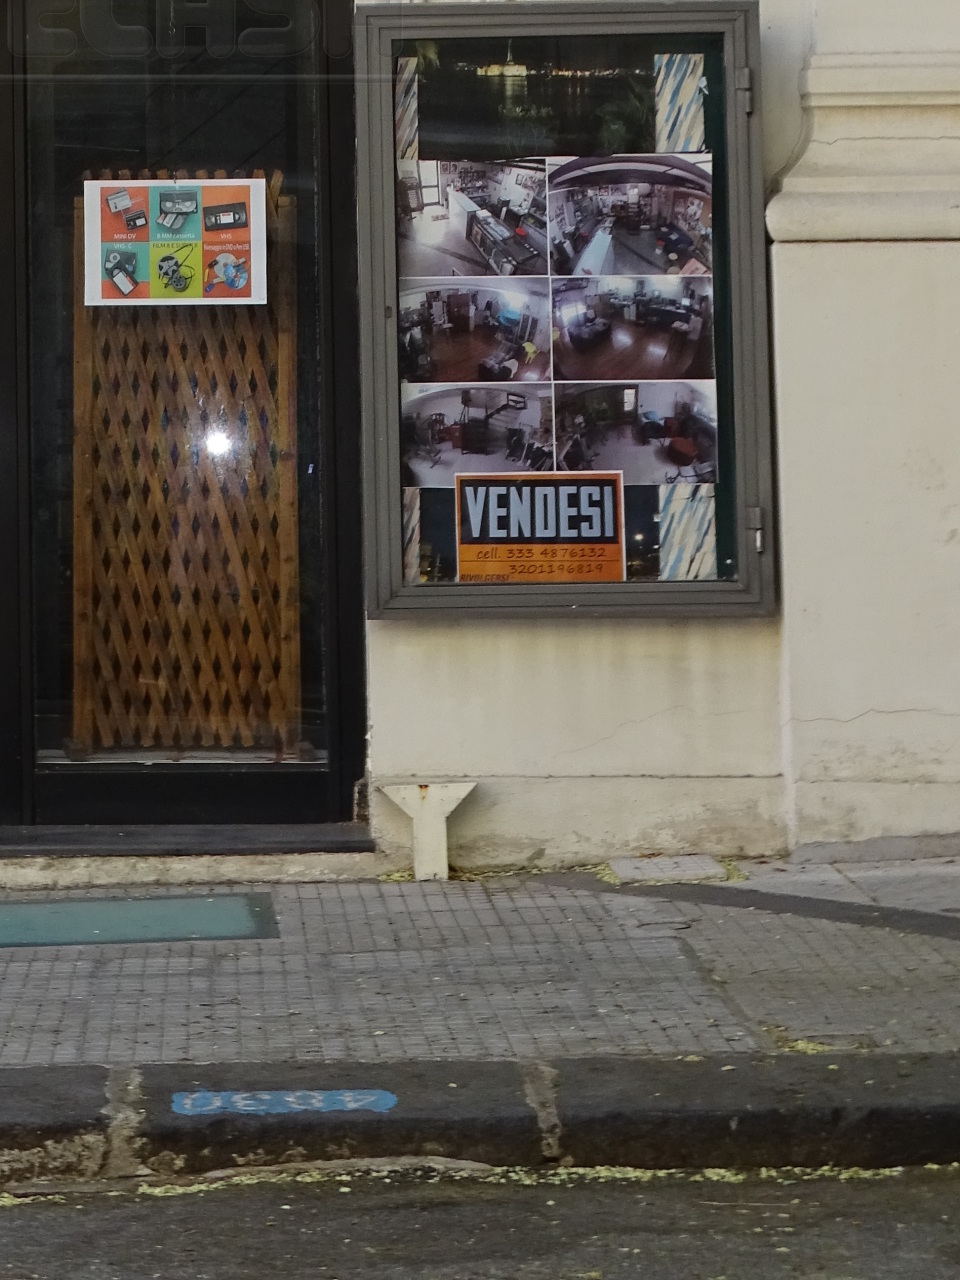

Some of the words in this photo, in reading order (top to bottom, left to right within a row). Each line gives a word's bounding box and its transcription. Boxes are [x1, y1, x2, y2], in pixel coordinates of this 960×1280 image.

[465, 486, 613, 538] VENDESI
[476, 548, 501, 560] cell.
[506, 548, 534, 559] 333
[540, 547, 607, 559] 4876132
[509, 563, 603, 574] 3201196819
